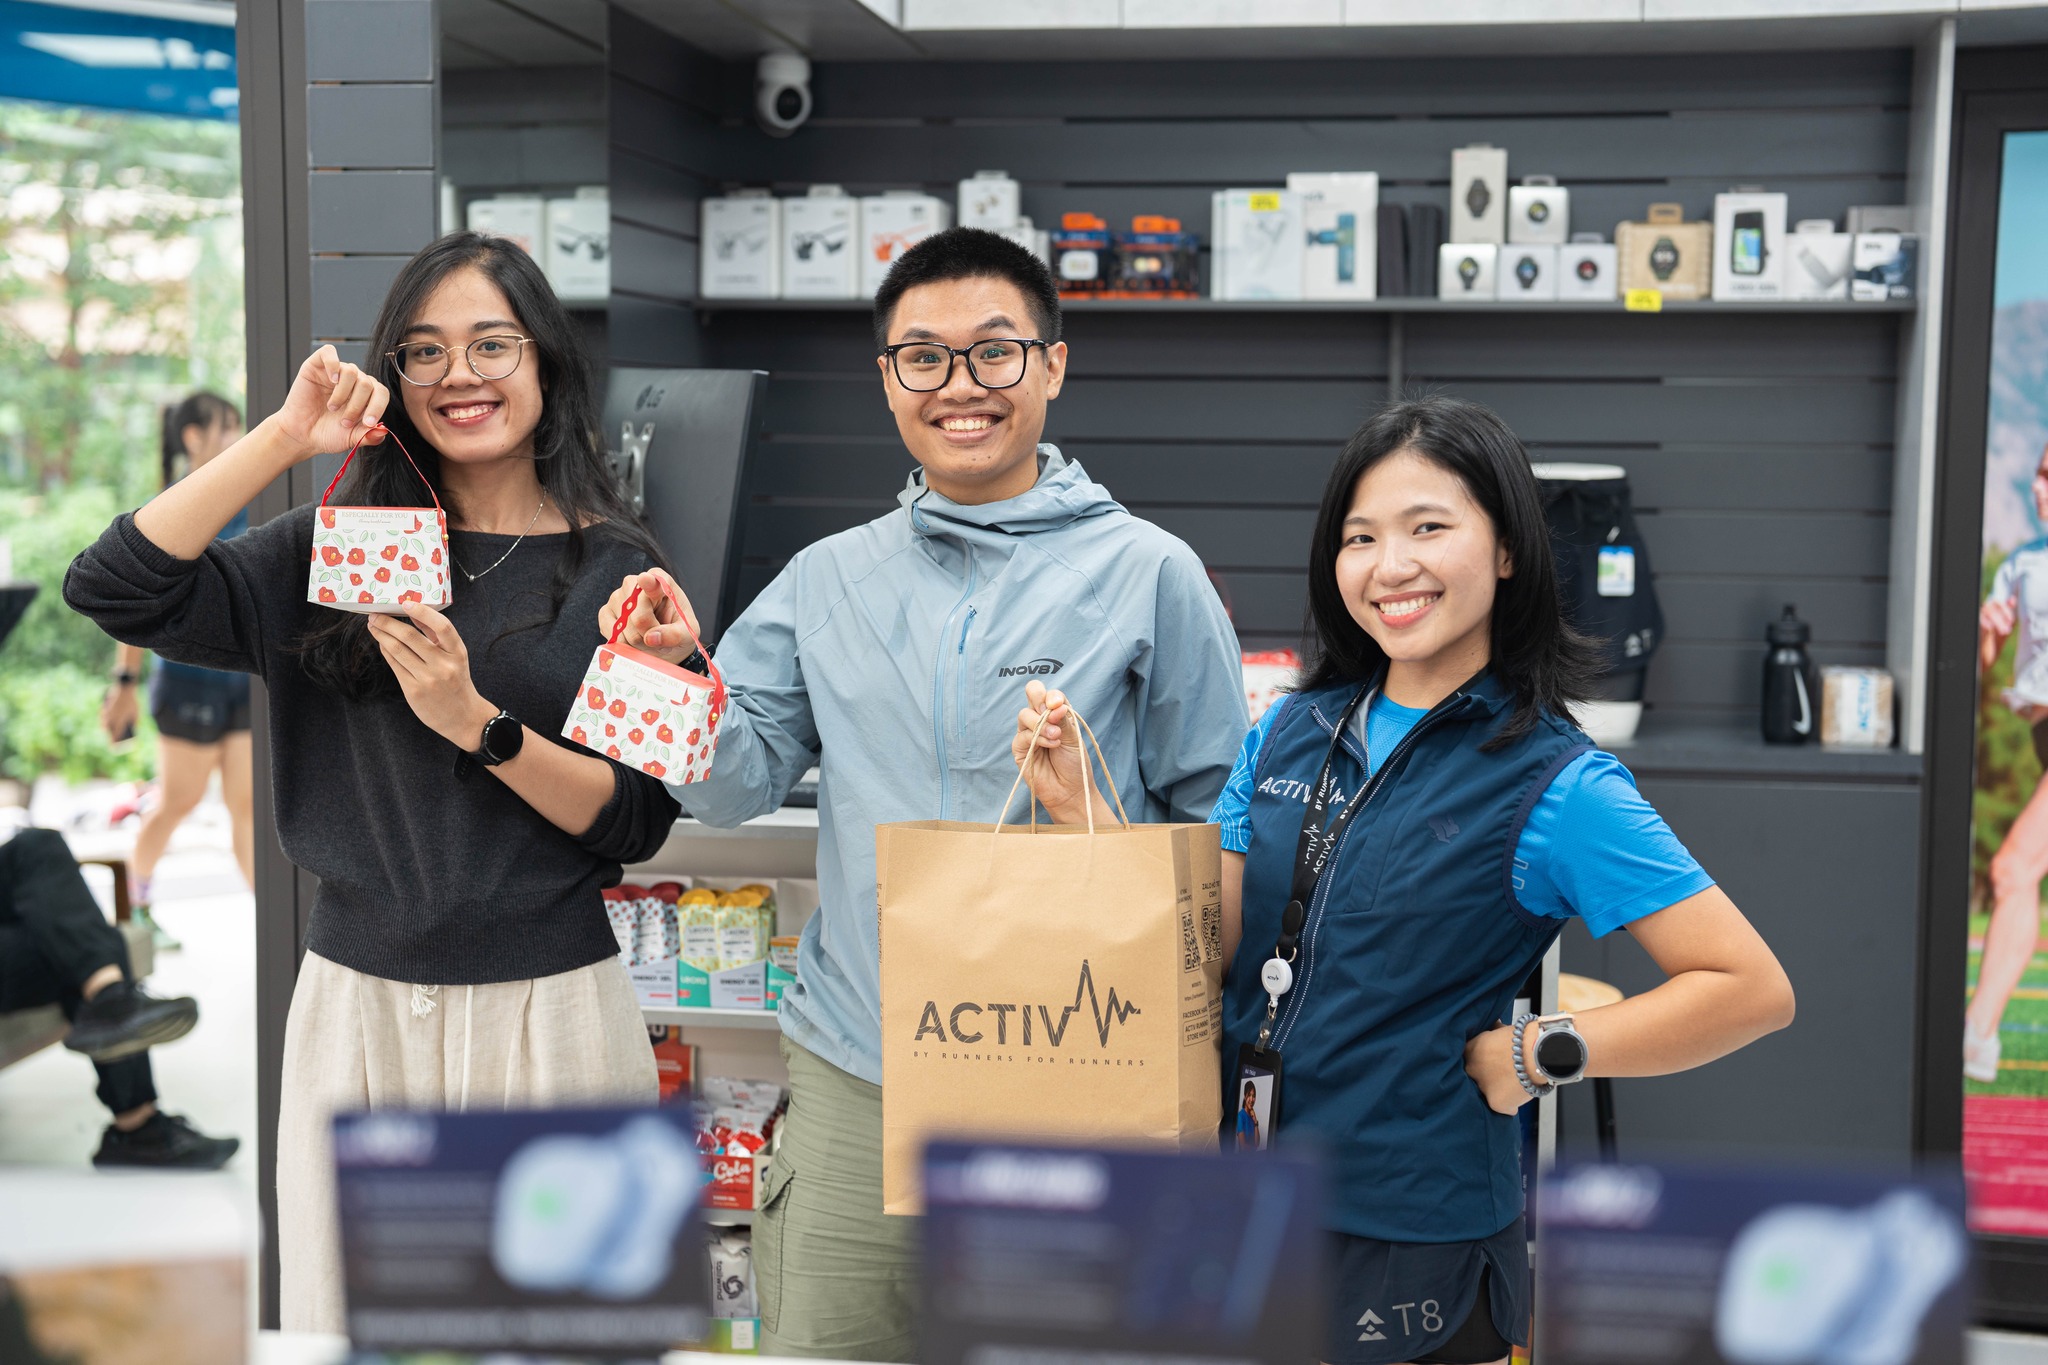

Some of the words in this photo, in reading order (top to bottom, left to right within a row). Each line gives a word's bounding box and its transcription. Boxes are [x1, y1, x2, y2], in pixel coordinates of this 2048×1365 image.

[619, 659, 654, 677] ESPECIALLY
[998, 664, 1051, 677] INOV8
[1315, 798, 1323, 811] BY
[942, 1052, 1013, 1062] RUNNERS
[1027, 1056, 1055, 1064] FOR
[1069, 1058, 1145, 1067] RUNNERS
[713, 1159, 752, 1180] Cola
[1392, 1299, 1443, 1336] T8
